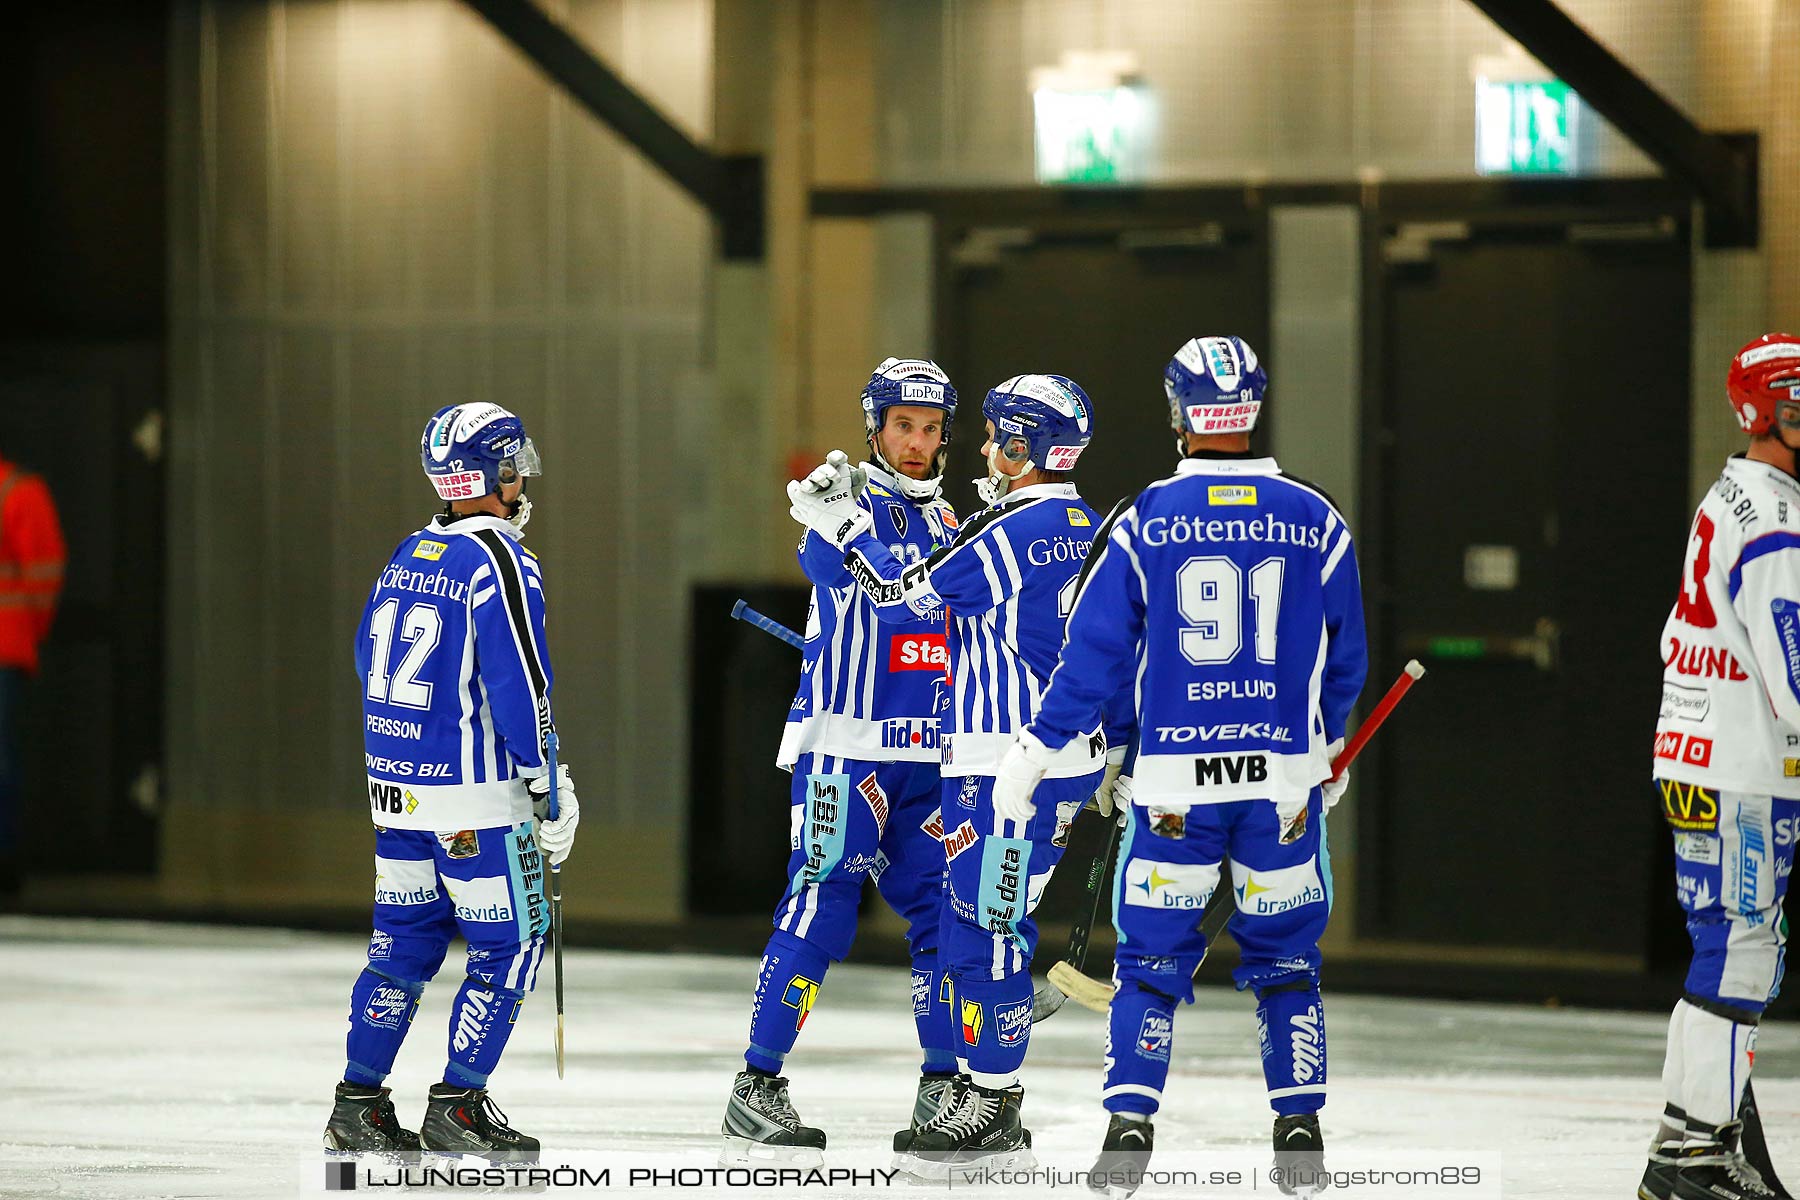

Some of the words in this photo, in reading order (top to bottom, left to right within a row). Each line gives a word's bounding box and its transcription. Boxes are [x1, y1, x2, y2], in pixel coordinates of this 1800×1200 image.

[1012, 416, 1038, 427] BAUER
[1204, 417, 1248, 430] BUSS
[448, 460, 465, 472] 12
[1142, 513, 1320, 549] Götenehus
[851, 559, 880, 600] Since
[1176, 555, 1285, 666] 91
[367, 597, 443, 711] 12
[366, 713, 422, 740] PERSSON
[417, 763, 454, 777] BIL
[1195, 755, 1268, 786] MVB
[996, 848, 1020, 903] data
[1258, 885, 1321, 914] bravida
[376, 987, 408, 1001] Villa
[383, 1015, 399, 1024] 1934
[453, 988, 495, 1053] Villa
[998, 1004, 1029, 1022] Villa
[1290, 1004, 1319, 1085] Villa
